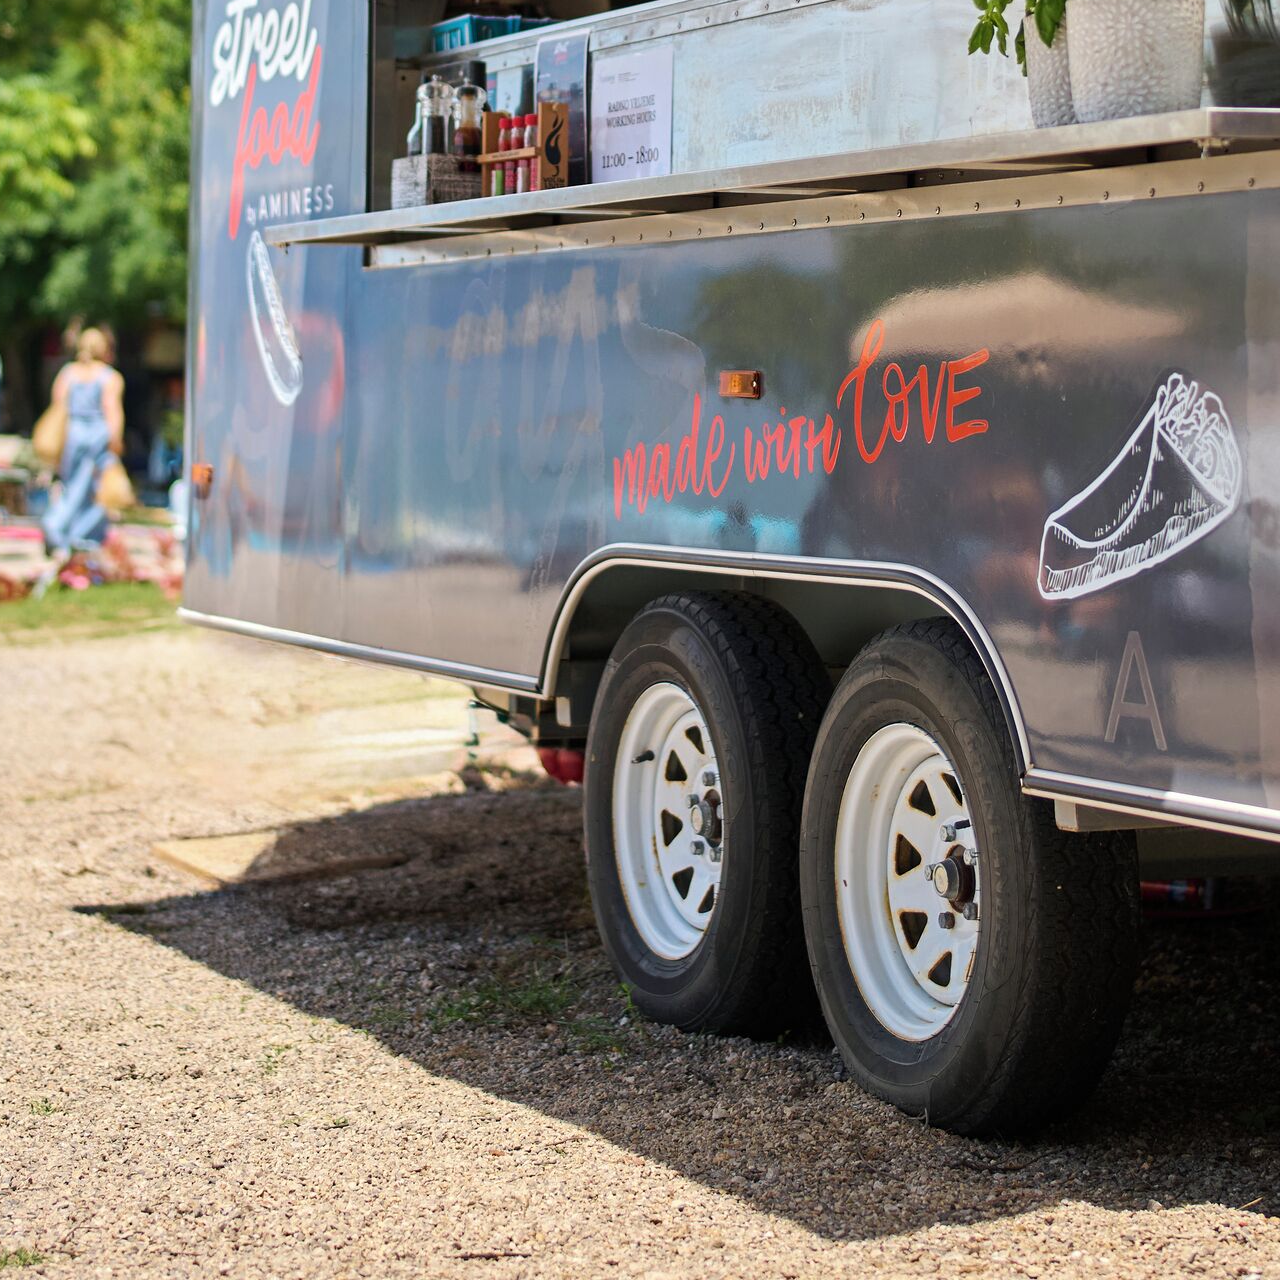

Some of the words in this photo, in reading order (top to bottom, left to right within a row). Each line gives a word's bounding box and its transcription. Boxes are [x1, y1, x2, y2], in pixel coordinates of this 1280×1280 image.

[228, 44, 322, 240] food
[602, 153, 625, 168] 11:00
[636, 146, 659, 164] 18:00
[606, 113, 635, 128] WORKING
[636, 110, 656, 125] HOURS
[258, 184, 335, 220] AMINESS
[613, 392, 735, 519] made
[1105, 630, 1167, 752] A
